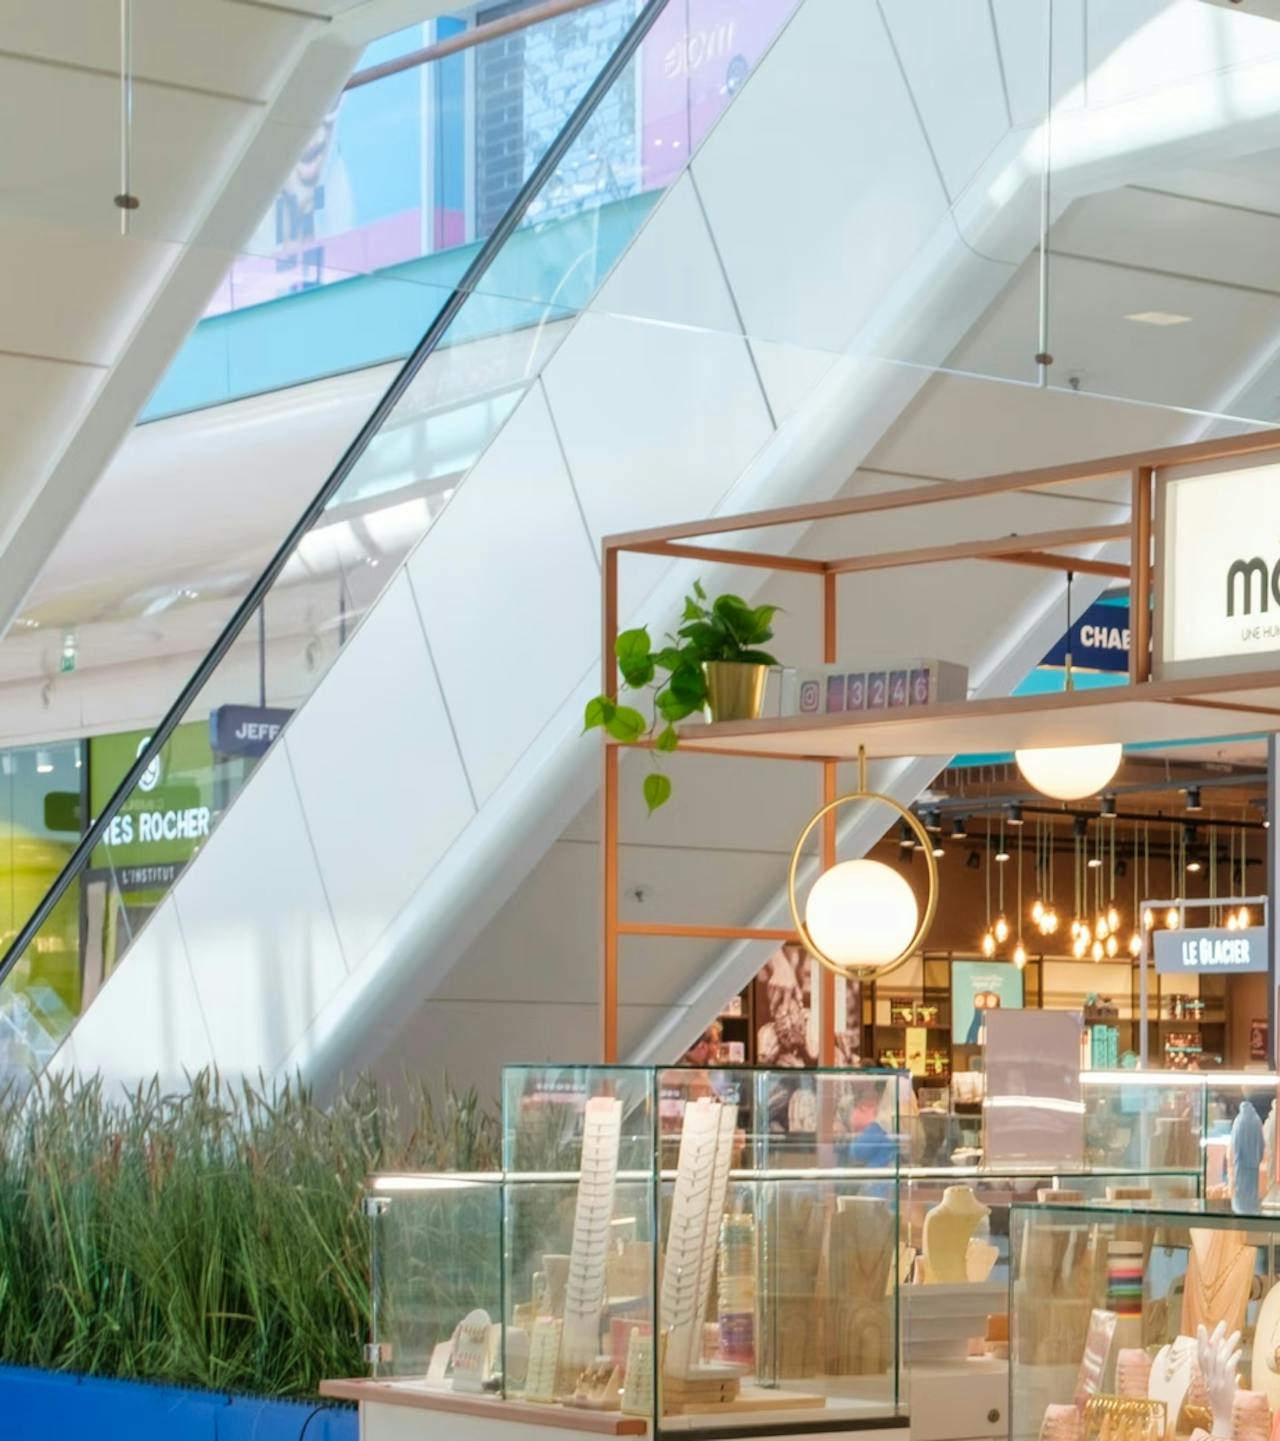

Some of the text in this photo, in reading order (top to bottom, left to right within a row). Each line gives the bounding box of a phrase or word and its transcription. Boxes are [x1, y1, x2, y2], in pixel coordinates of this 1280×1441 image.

[139, 806, 210, 843] ROCHER
[1182, 937, 1251, 966] LE GLACIER
